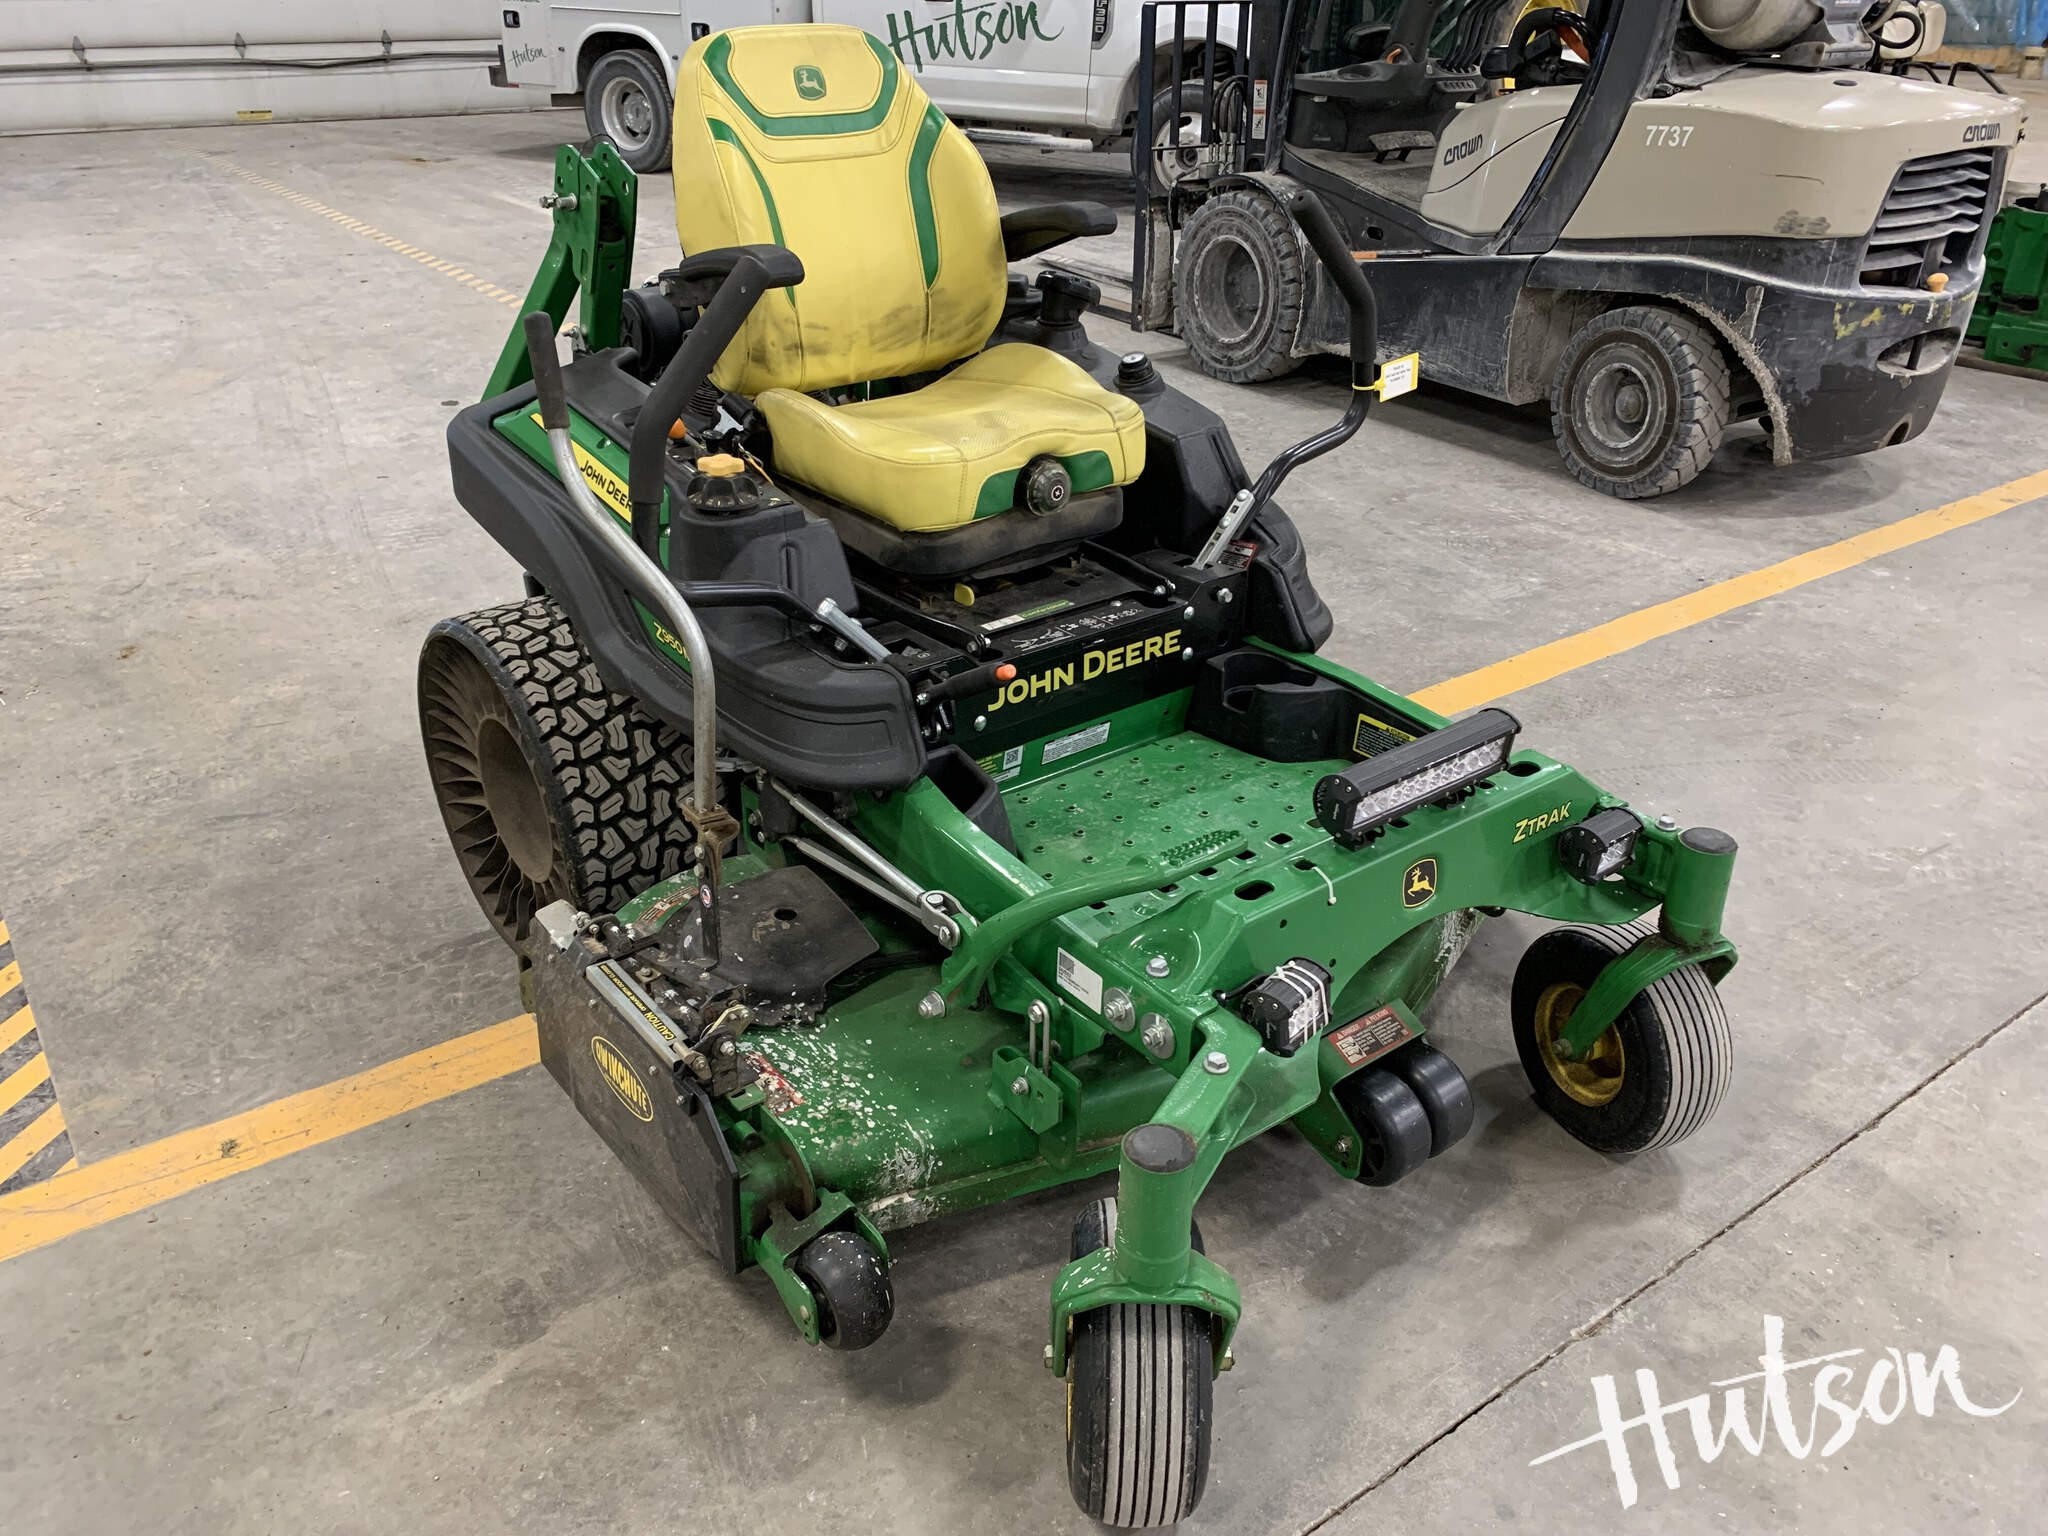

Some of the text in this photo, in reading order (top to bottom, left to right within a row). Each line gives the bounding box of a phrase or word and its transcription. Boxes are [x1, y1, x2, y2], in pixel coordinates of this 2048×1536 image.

[888, 0, 1064, 73] Hutson
[508, 43, 547, 68] Hutson
[1646, 125, 1694, 147] 7737
[1963, 123, 2001, 142] CROWN
[1443, 134, 1482, 165] CROWN
[580, 460, 632, 513] JOHN DEER
[987, 629, 1182, 712] JOHN DEERE
[1513, 801, 1571, 843] ZTRAK
[645, 1011, 675, 1040] CAUTION
